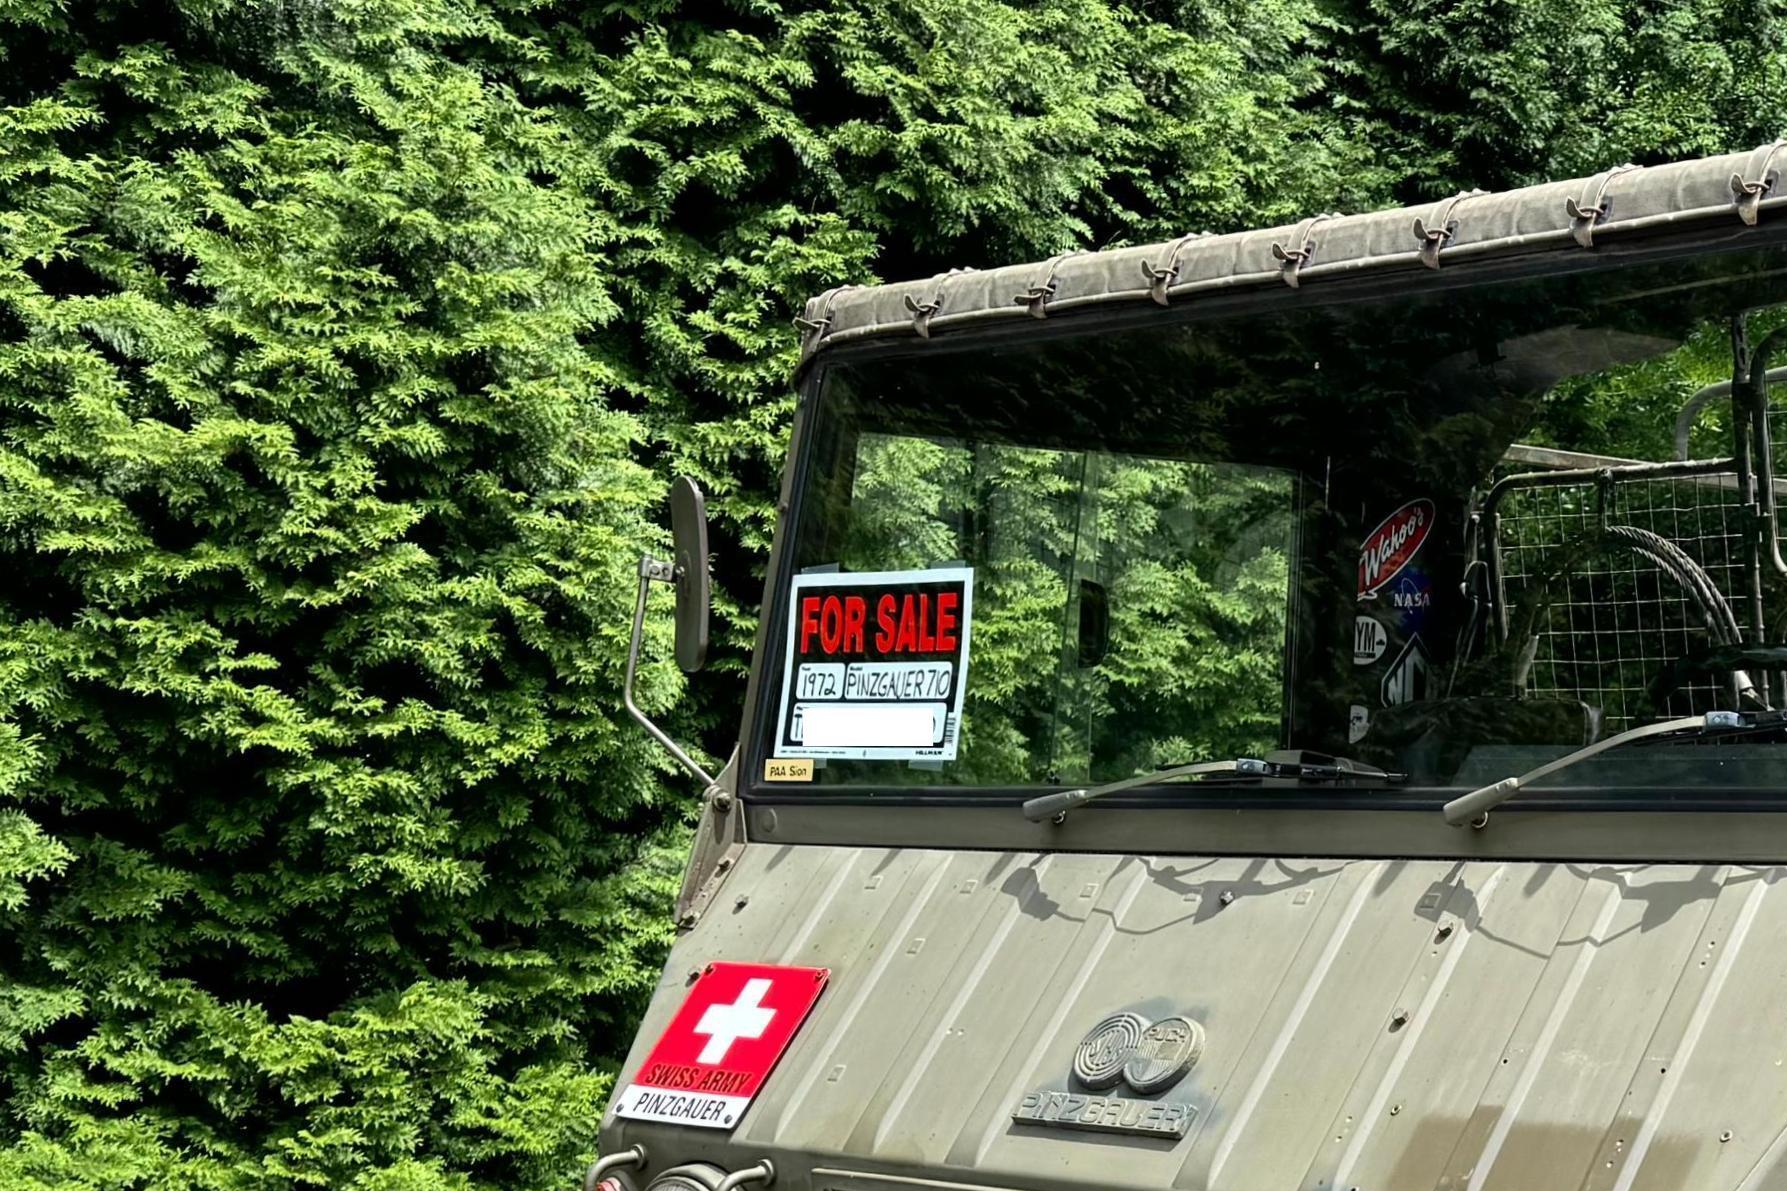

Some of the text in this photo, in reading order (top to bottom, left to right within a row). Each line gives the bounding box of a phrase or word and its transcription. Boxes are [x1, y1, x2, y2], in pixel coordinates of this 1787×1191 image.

[1360, 506, 1425, 587] Wahoo's
[1394, 592, 1431, 608] NASA
[800, 592, 958, 654] FOR SALE
[802, 672, 837, 698] 1972
[846, 668, 951, 699] PINZGAUER 710
[645, 1063, 752, 1094] SWISS ARMY
[632, 1092, 727, 1121] PINZGAUER
[1018, 1091, 1187, 1131] PINZGAUER
